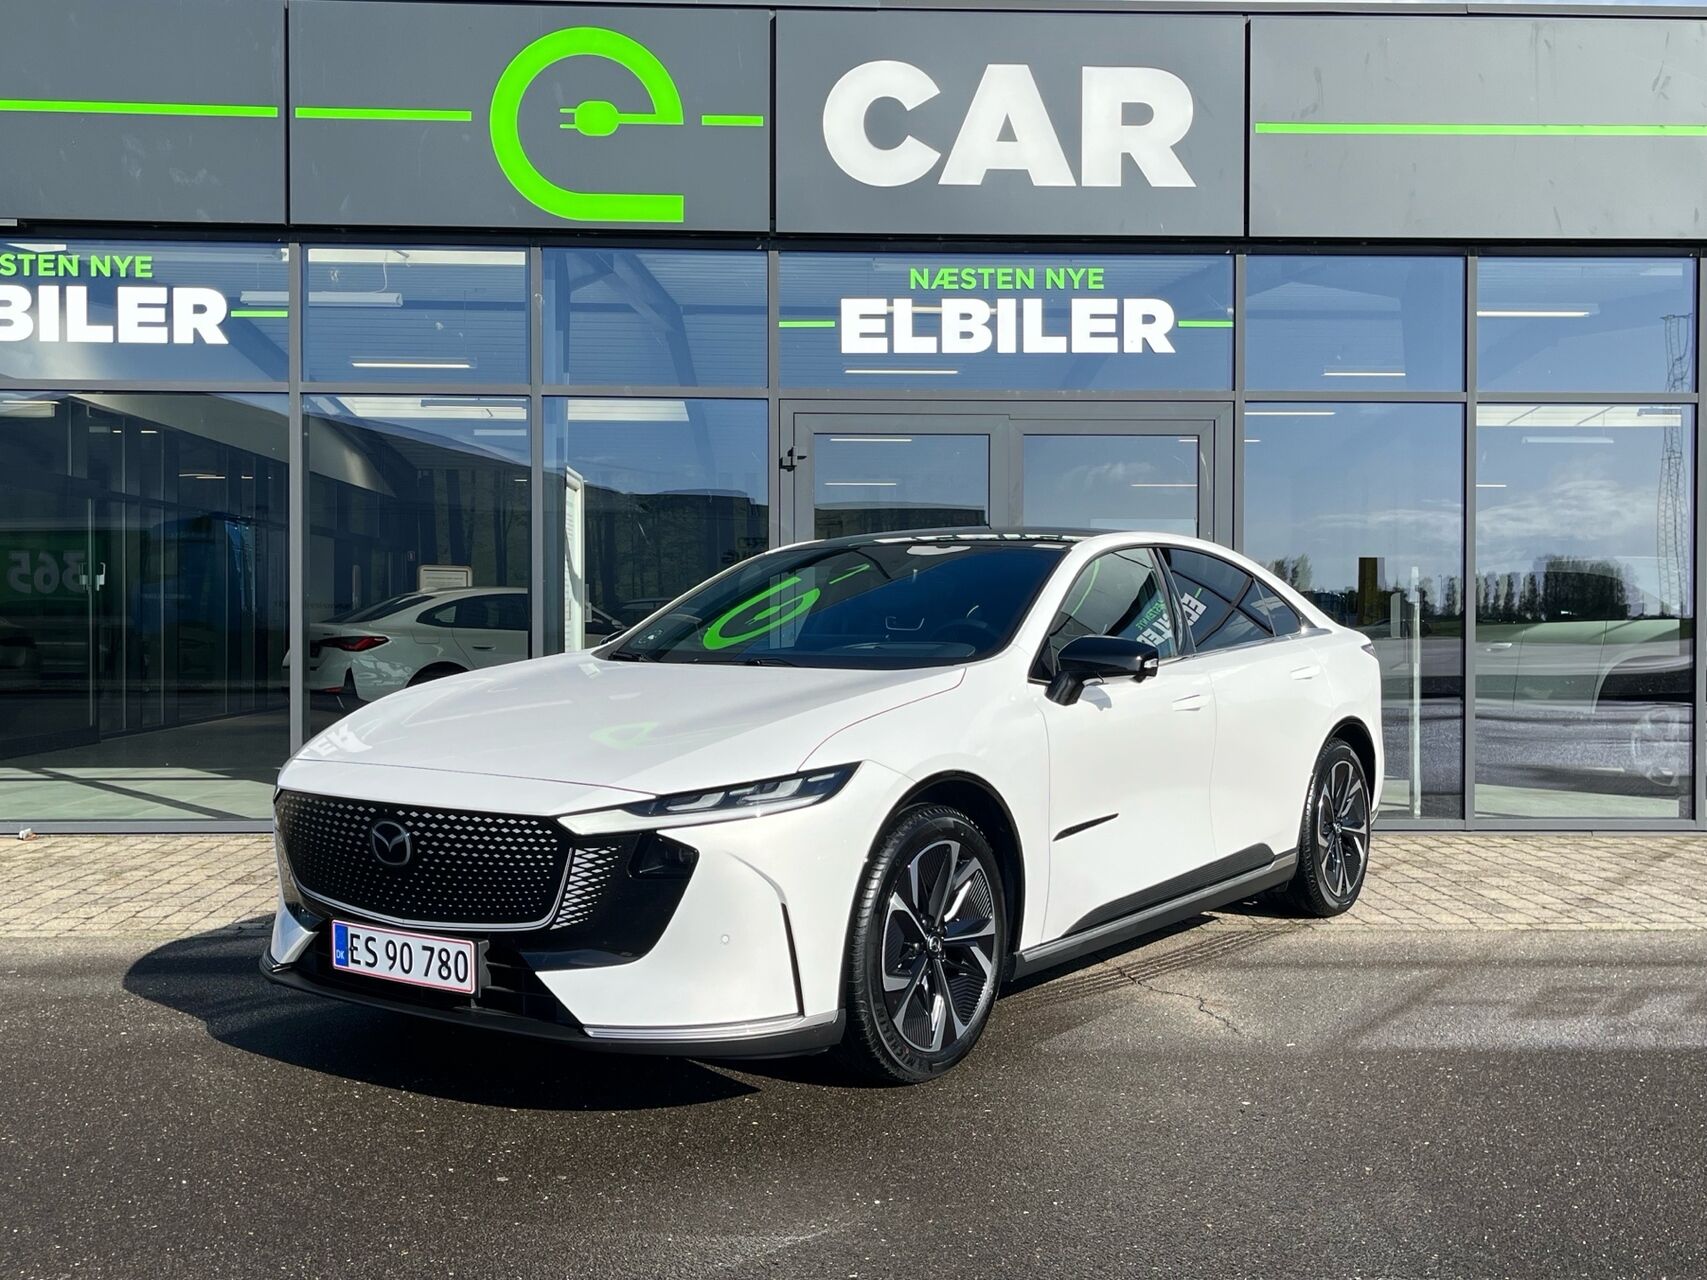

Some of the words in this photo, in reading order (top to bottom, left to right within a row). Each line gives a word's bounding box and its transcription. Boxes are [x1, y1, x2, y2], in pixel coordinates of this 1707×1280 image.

[822, 60, 1197, 188] CAR
[89, 254, 153, 278] NYE
[909, 266, 1036, 290] NÆSTEN
[1045, 267, 1105, 290] NYE
[839, 297, 1176, 355] ELBILER
[336, 949, 345, 960] DK
[349, 932, 378, 969] ES
[385, 939, 414, 975] 90
[421, 945, 469, 984] 780
